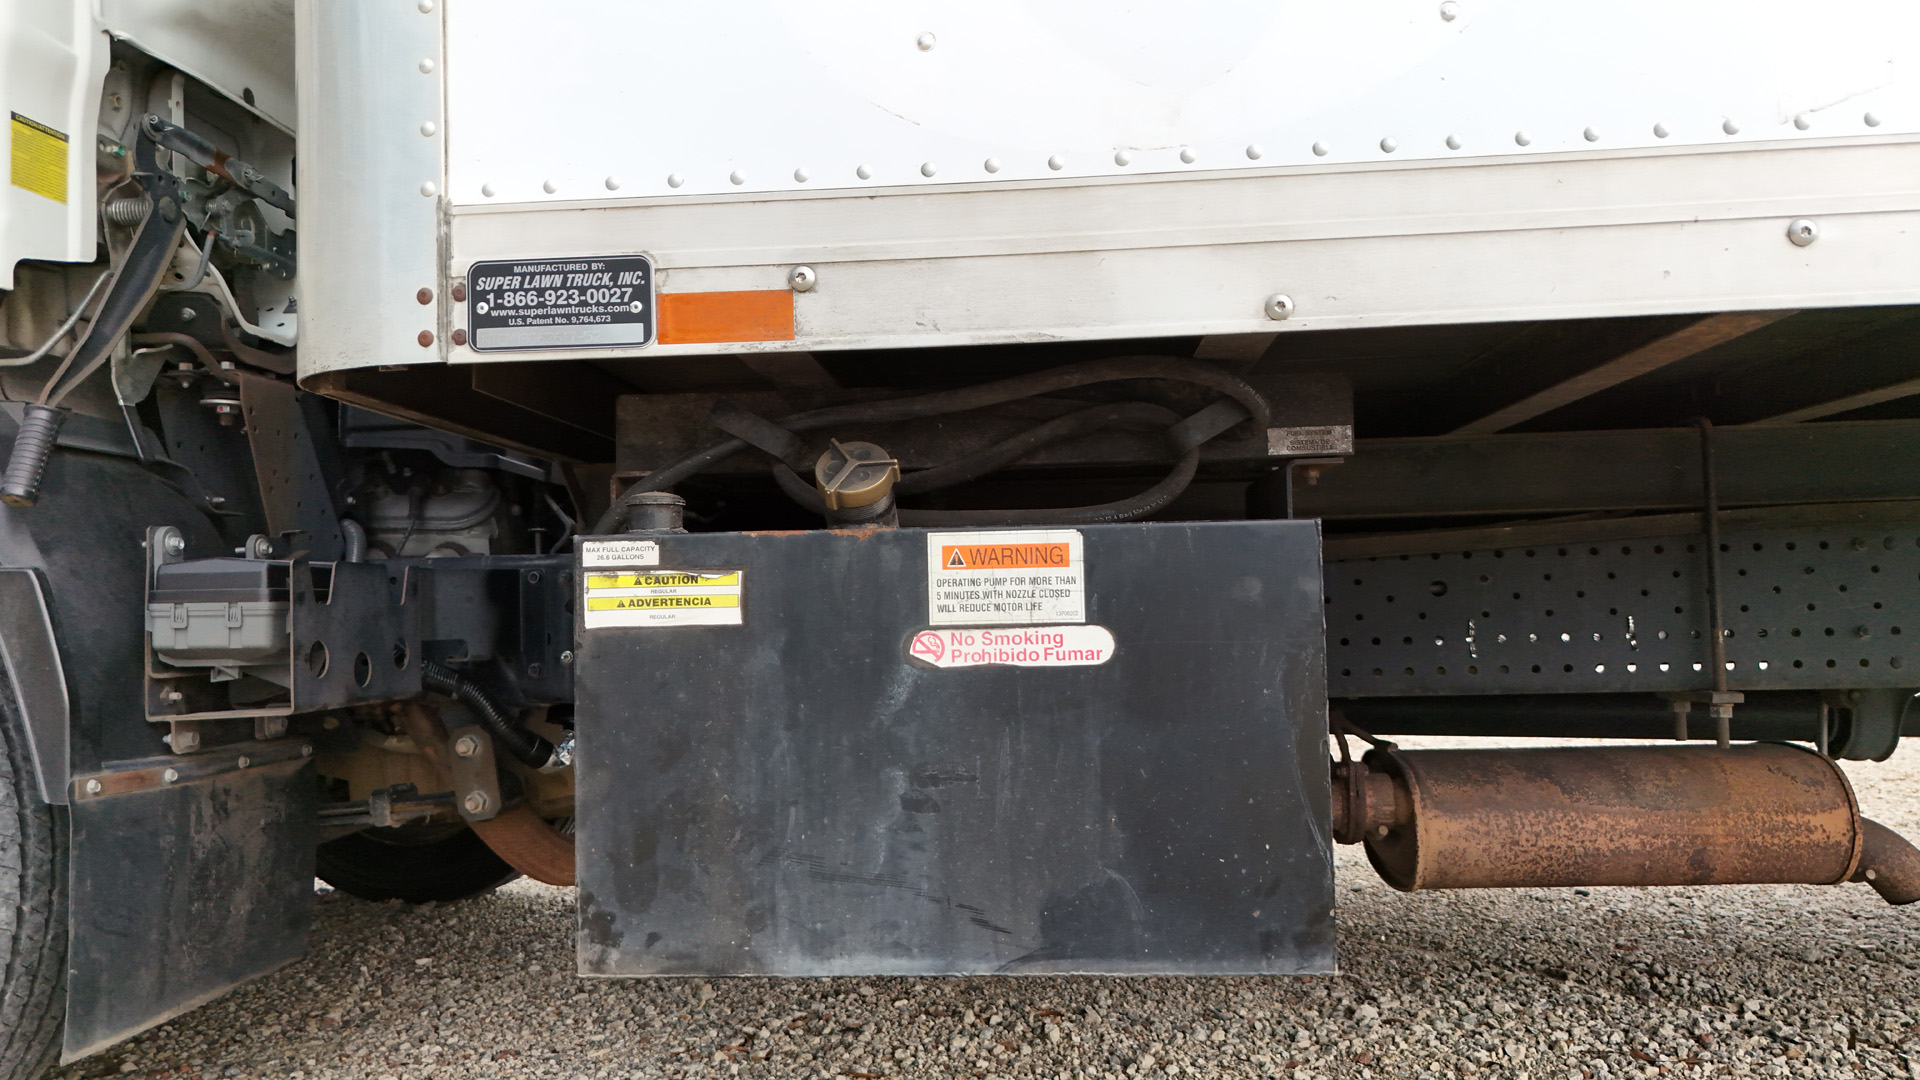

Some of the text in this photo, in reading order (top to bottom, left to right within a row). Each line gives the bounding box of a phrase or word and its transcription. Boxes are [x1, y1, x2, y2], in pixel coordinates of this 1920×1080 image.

[514, 262, 606, 273] MANUFACTURED BY:
[476, 272, 645, 291] SUPER LAWN TRUCK, INC.
[486, 288, 633, 307] 1-866-923-0027
[490, 304, 630, 317] www.superlawntrucks.com
[571, 315, 611, 324] 9,764,673
[970, 546, 1064, 565] WARNING
[644, 575, 698, 585] CAUTION
[936, 576, 1077, 587] OPERATING PUMP FOR MORE THAN
[936, 589, 1071, 600] 5 MINUTES WITH NOZZLE CLOSED
[628, 597, 712, 607] ADVERTENCIA
[937, 602, 1042, 613] WILL REDUCE MOTOR LIFE
[950, 631, 1063, 648] No Smoking
[951, 647, 1103, 664] Prohibido Fumar
